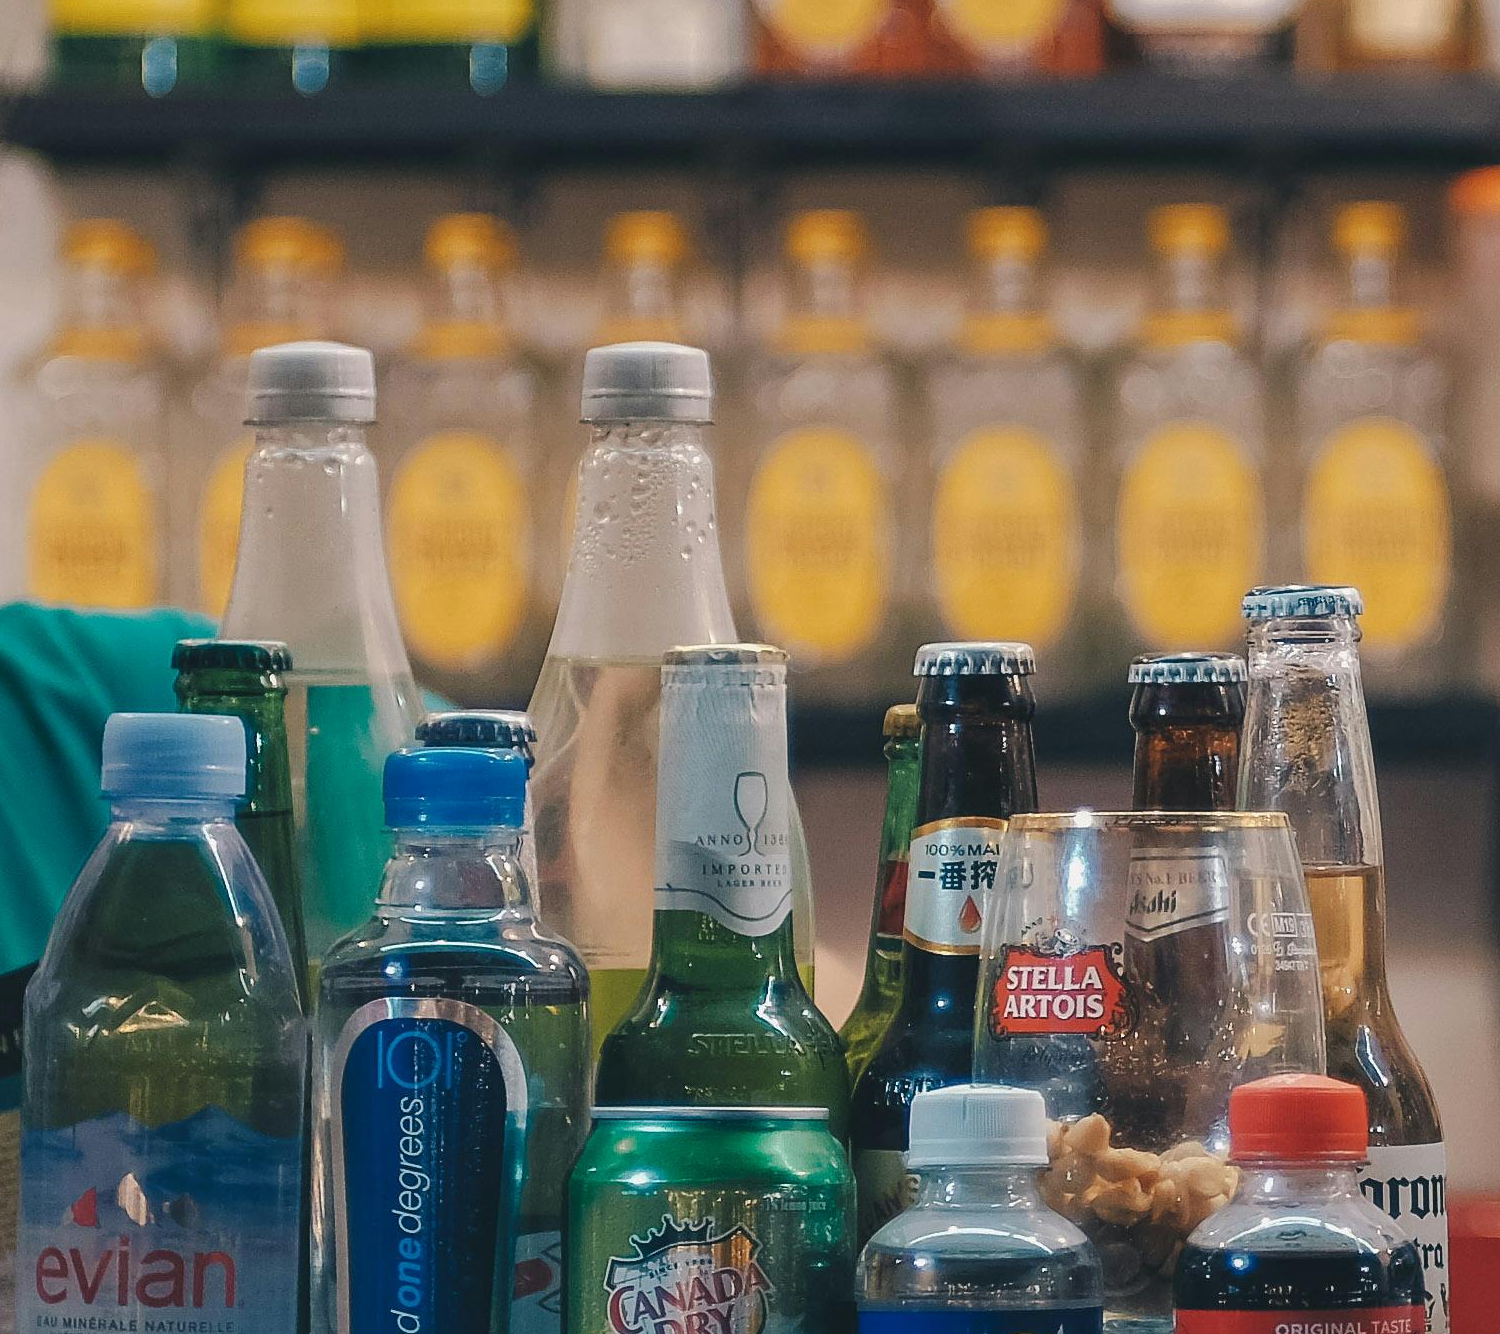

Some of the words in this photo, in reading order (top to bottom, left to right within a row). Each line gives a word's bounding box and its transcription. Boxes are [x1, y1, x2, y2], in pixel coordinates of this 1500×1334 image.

[697, 833, 744, 846] ANNO
[924, 843, 966, 857] 100%
[1006, 966, 1104, 991] STELLA
[1003, 994, 1105, 1019] ARTOIS
[36, 1234, 237, 1309] evian
[398, 1236, 422, 1308] one
[1371, 1318, 1412, 1334] TASTE
